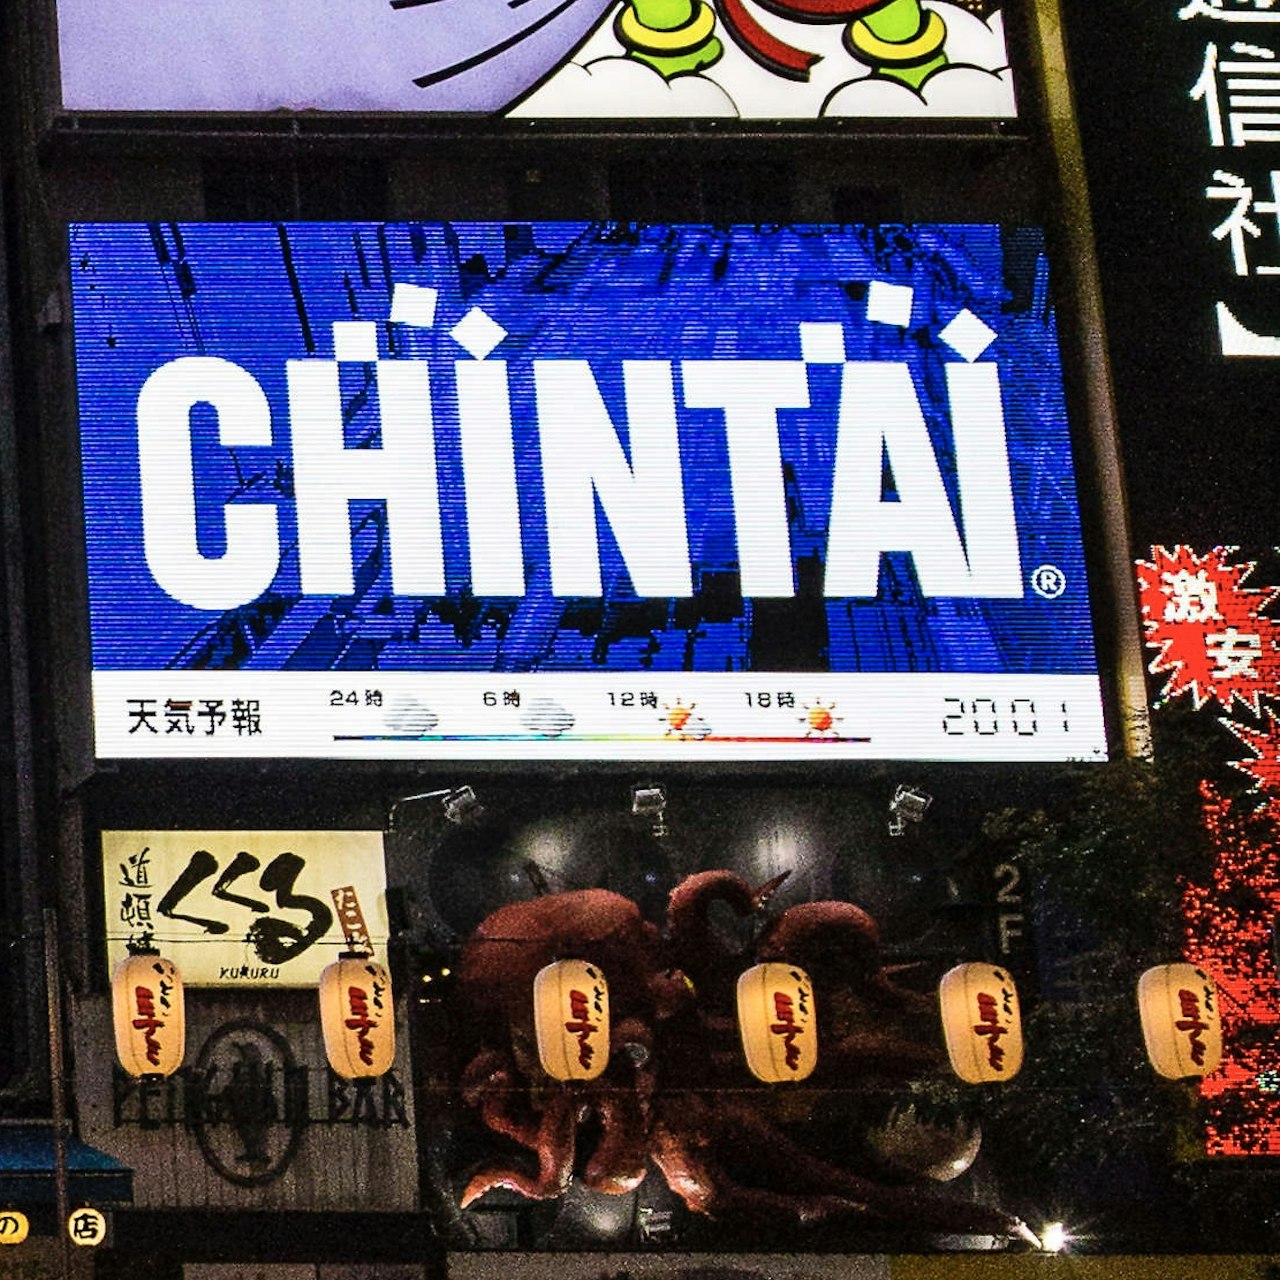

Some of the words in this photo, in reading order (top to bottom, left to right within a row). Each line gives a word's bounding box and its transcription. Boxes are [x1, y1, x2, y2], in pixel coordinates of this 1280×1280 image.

[136, 282, 1032, 612] CHINTAI
[126, 698, 263, 736] 天気予報
[219, 965, 282, 981] KURURU
